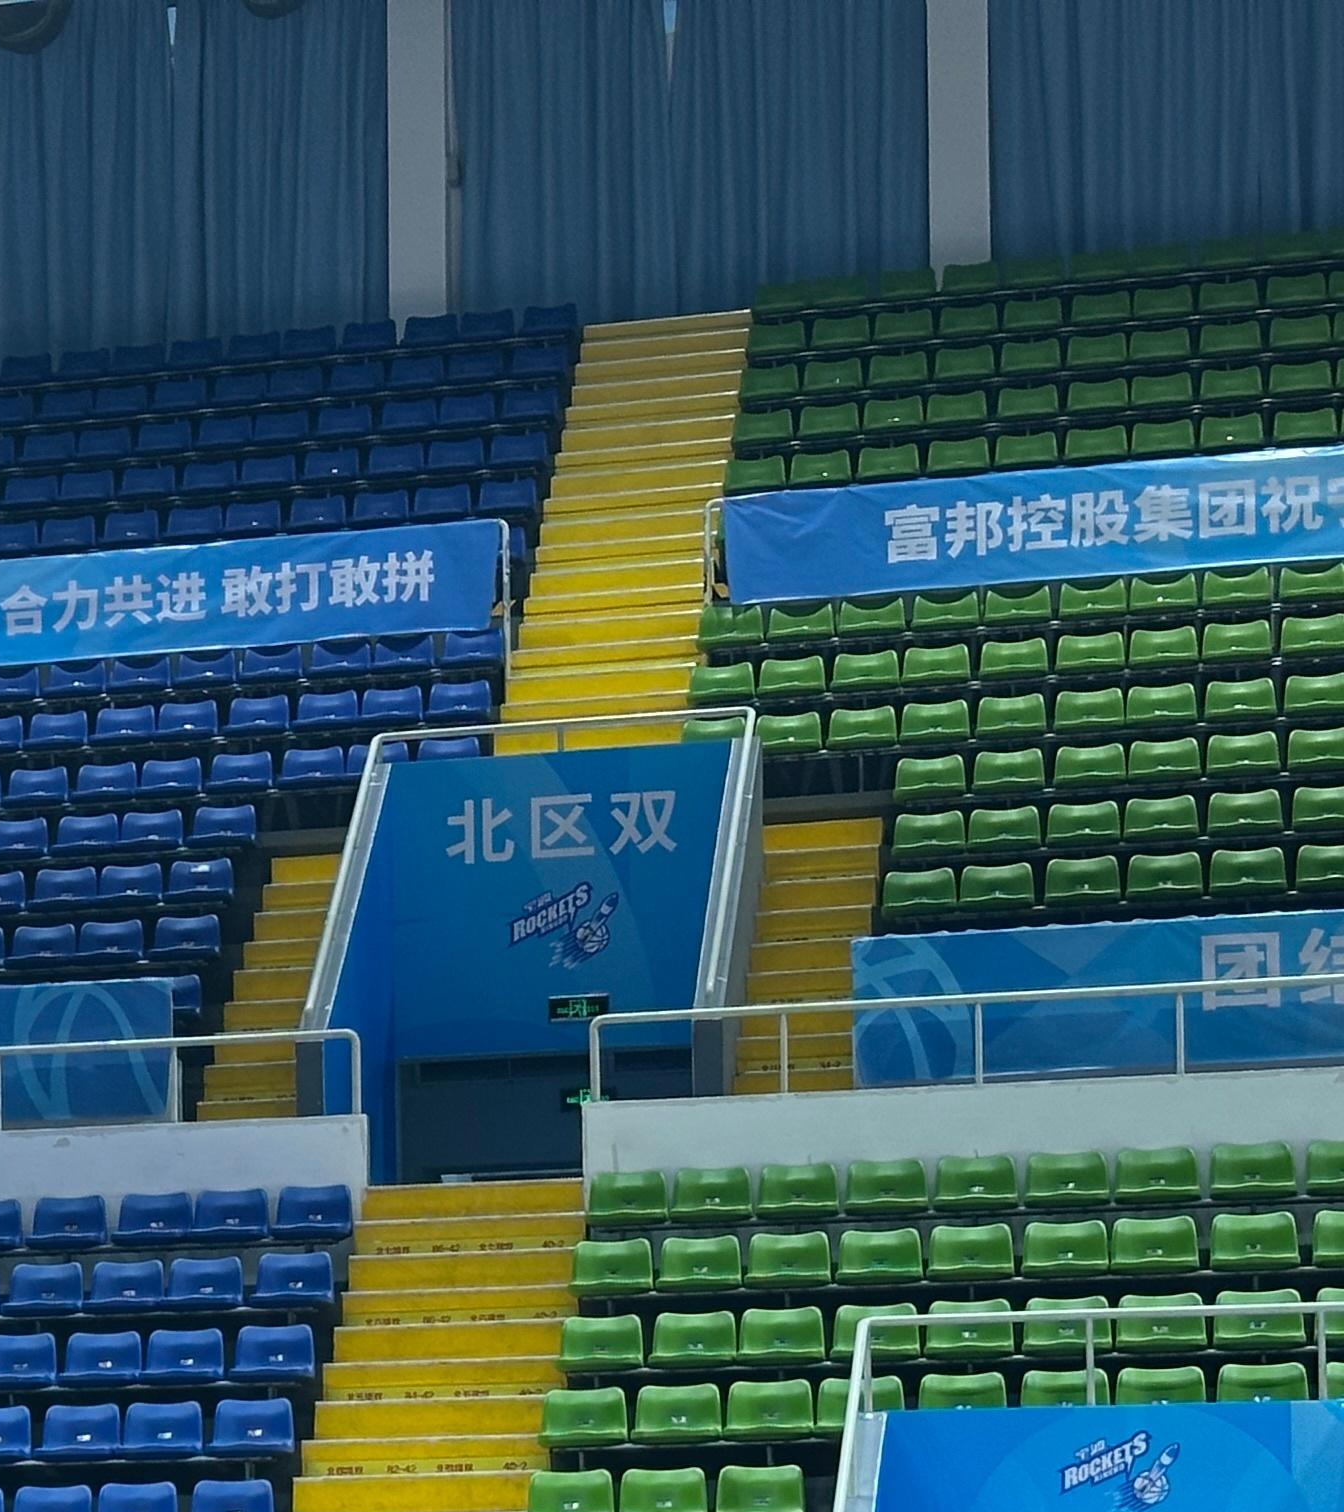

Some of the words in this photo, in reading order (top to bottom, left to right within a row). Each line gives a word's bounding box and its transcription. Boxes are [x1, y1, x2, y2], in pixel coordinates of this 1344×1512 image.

[220, 549, 435, 619] 敢打敢拼
[445, 789, 678, 865] 北区双
[512, 883, 592, 943] ROCKETS
[1063, 1432, 1148, 1491] ROCKETS
